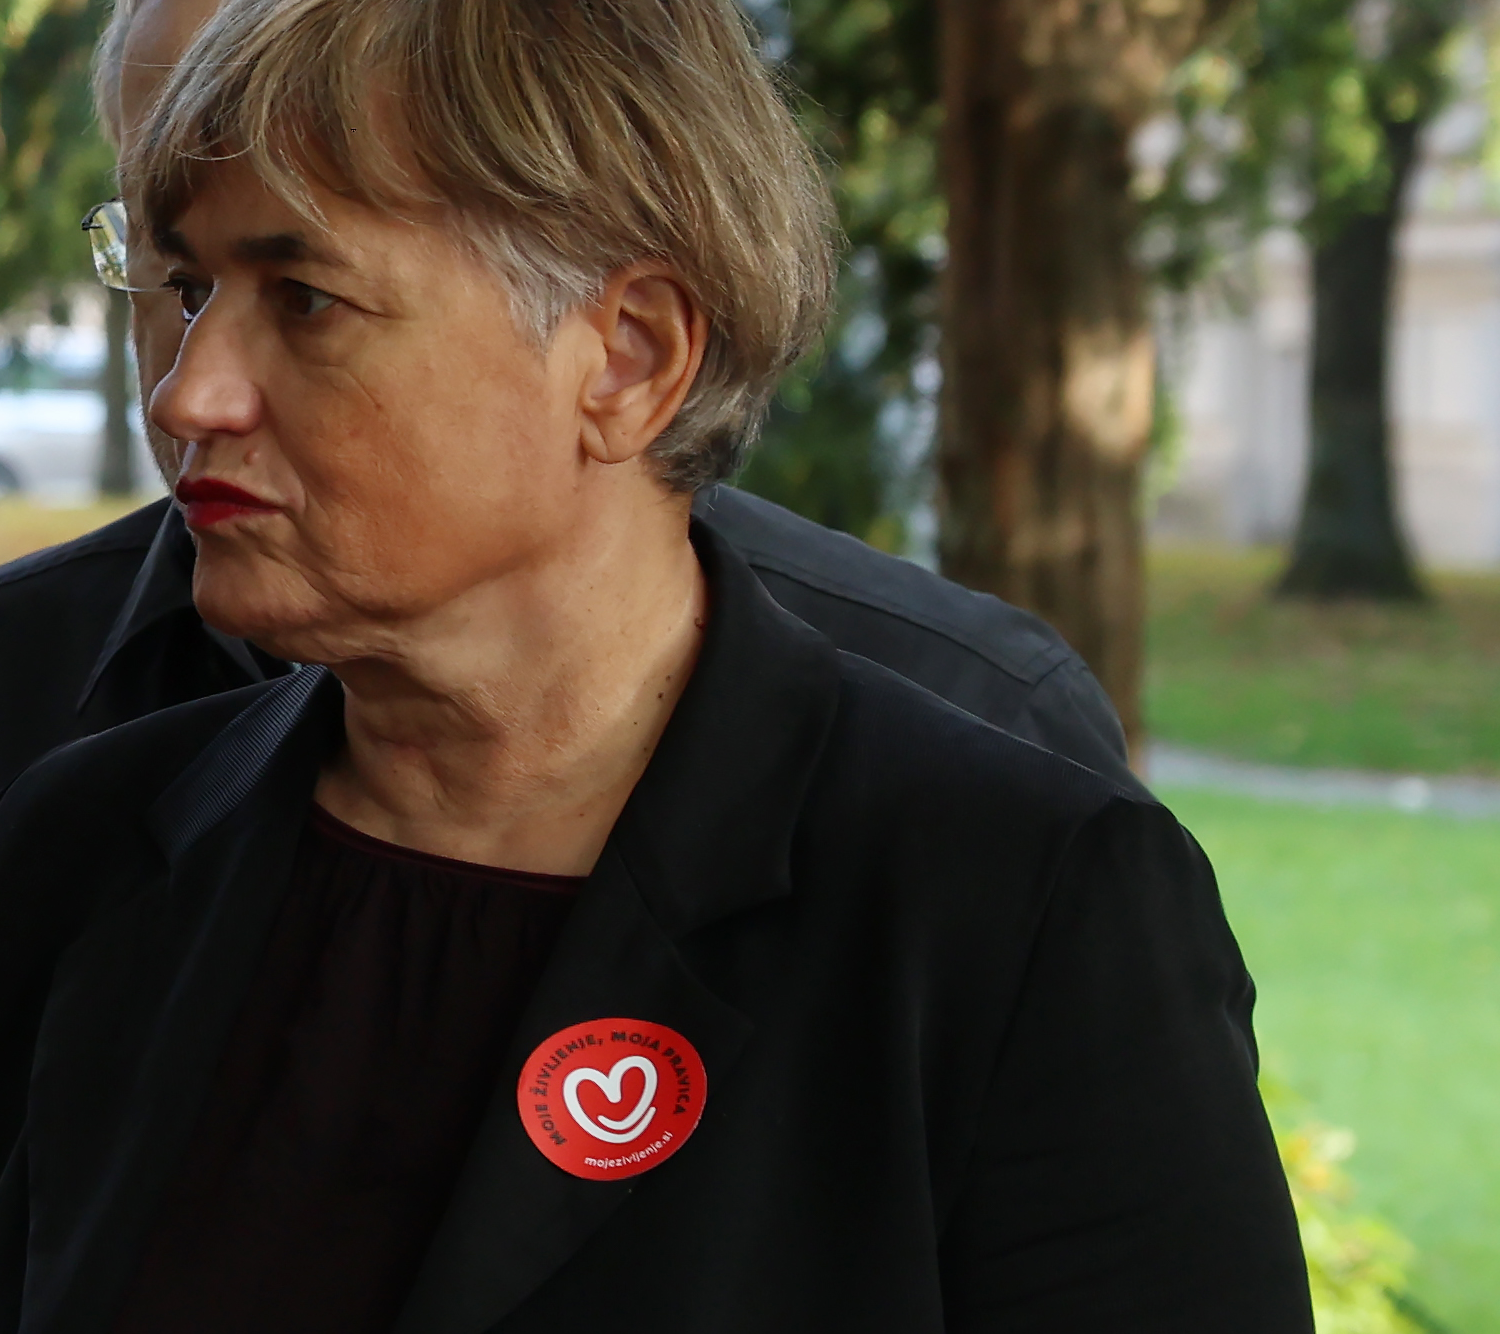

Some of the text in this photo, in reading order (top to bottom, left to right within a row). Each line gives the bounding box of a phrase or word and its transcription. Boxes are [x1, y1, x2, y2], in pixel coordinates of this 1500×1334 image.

[535, 1104, 567, 1147] MOJE
[611, 1030, 661, 1051] MOJA
[662, 1046, 692, 1116] PRAVICA
